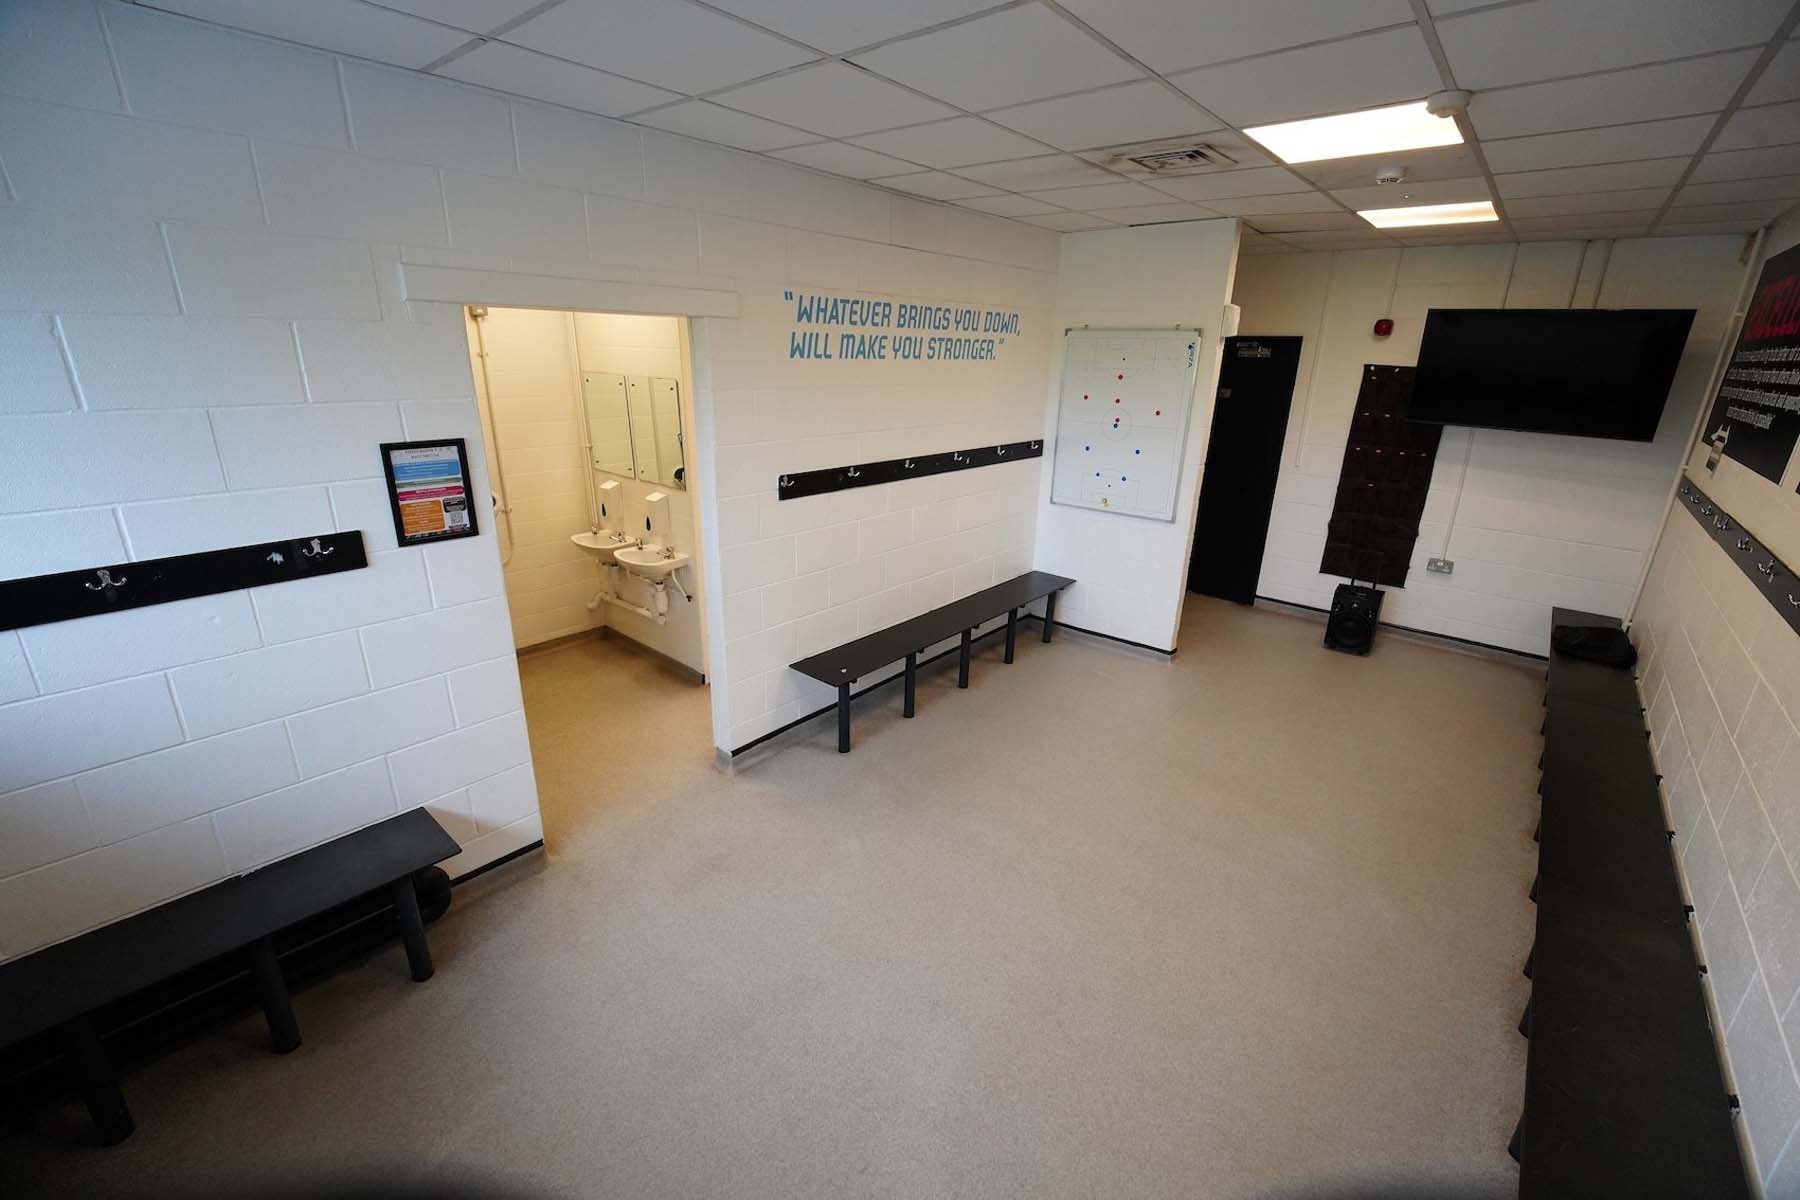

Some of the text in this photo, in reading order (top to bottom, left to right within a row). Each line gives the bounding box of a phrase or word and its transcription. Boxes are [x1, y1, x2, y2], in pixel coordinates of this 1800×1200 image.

[897, 304, 951, 330] BRINGS
[954, 309, 981, 331] YOU
[983, 311, 1021, 336] DOWN,
[790, 332, 832, 359] WILL
[839, 334, 888, 359] MAKE
[892, 336, 922, 360] YOU
